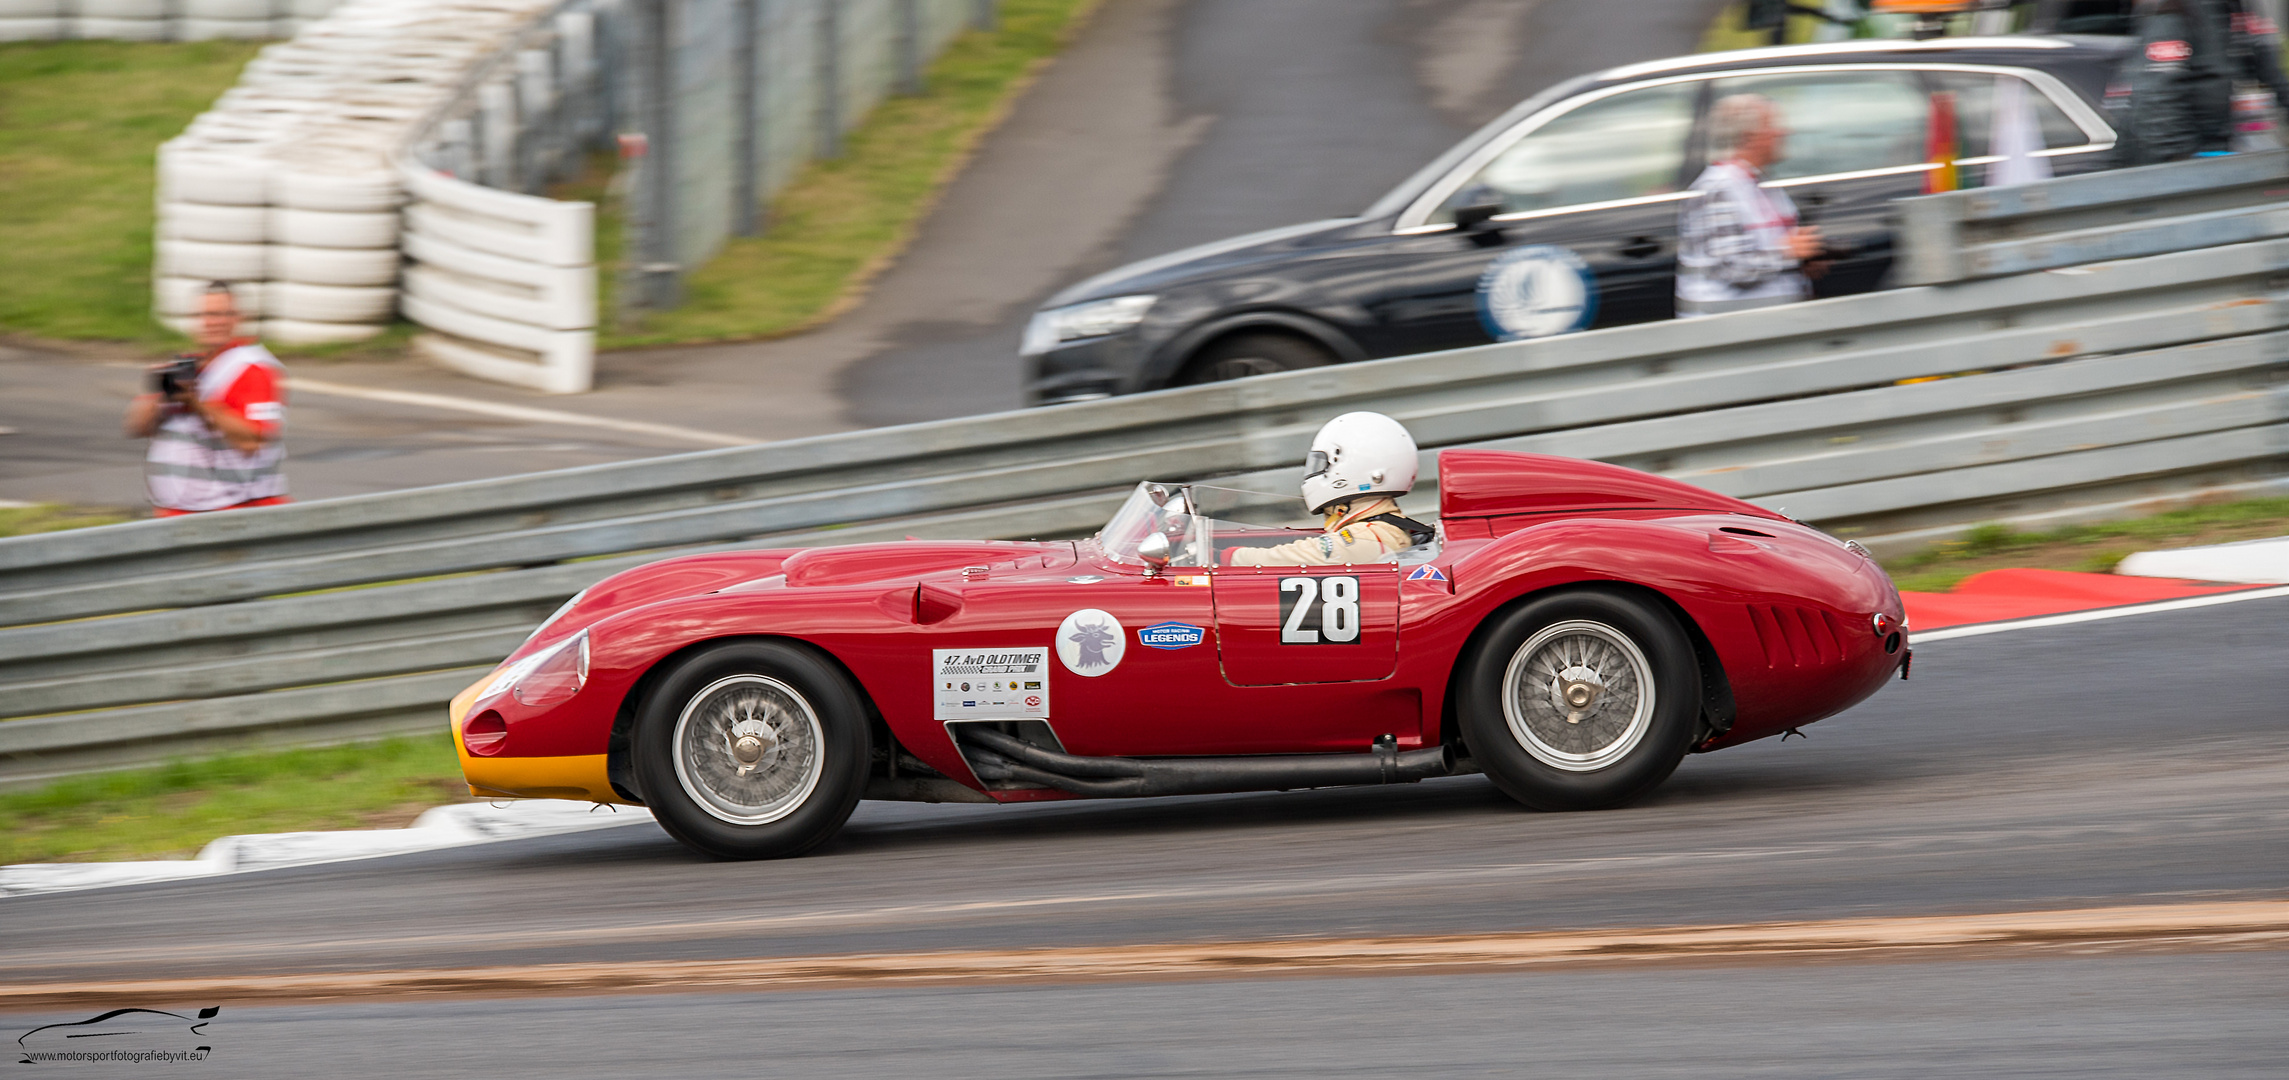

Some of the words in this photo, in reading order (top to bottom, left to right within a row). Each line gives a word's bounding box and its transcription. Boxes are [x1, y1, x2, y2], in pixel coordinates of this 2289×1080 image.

[1279, 576, 1360, 644] 28
[1144, 633, 1199, 643] LEGENDS
[944, 655, 961, 666] 47.
[962, 654, 985, 665] AvD
[986, 653, 1041, 665] OLDTIMER
